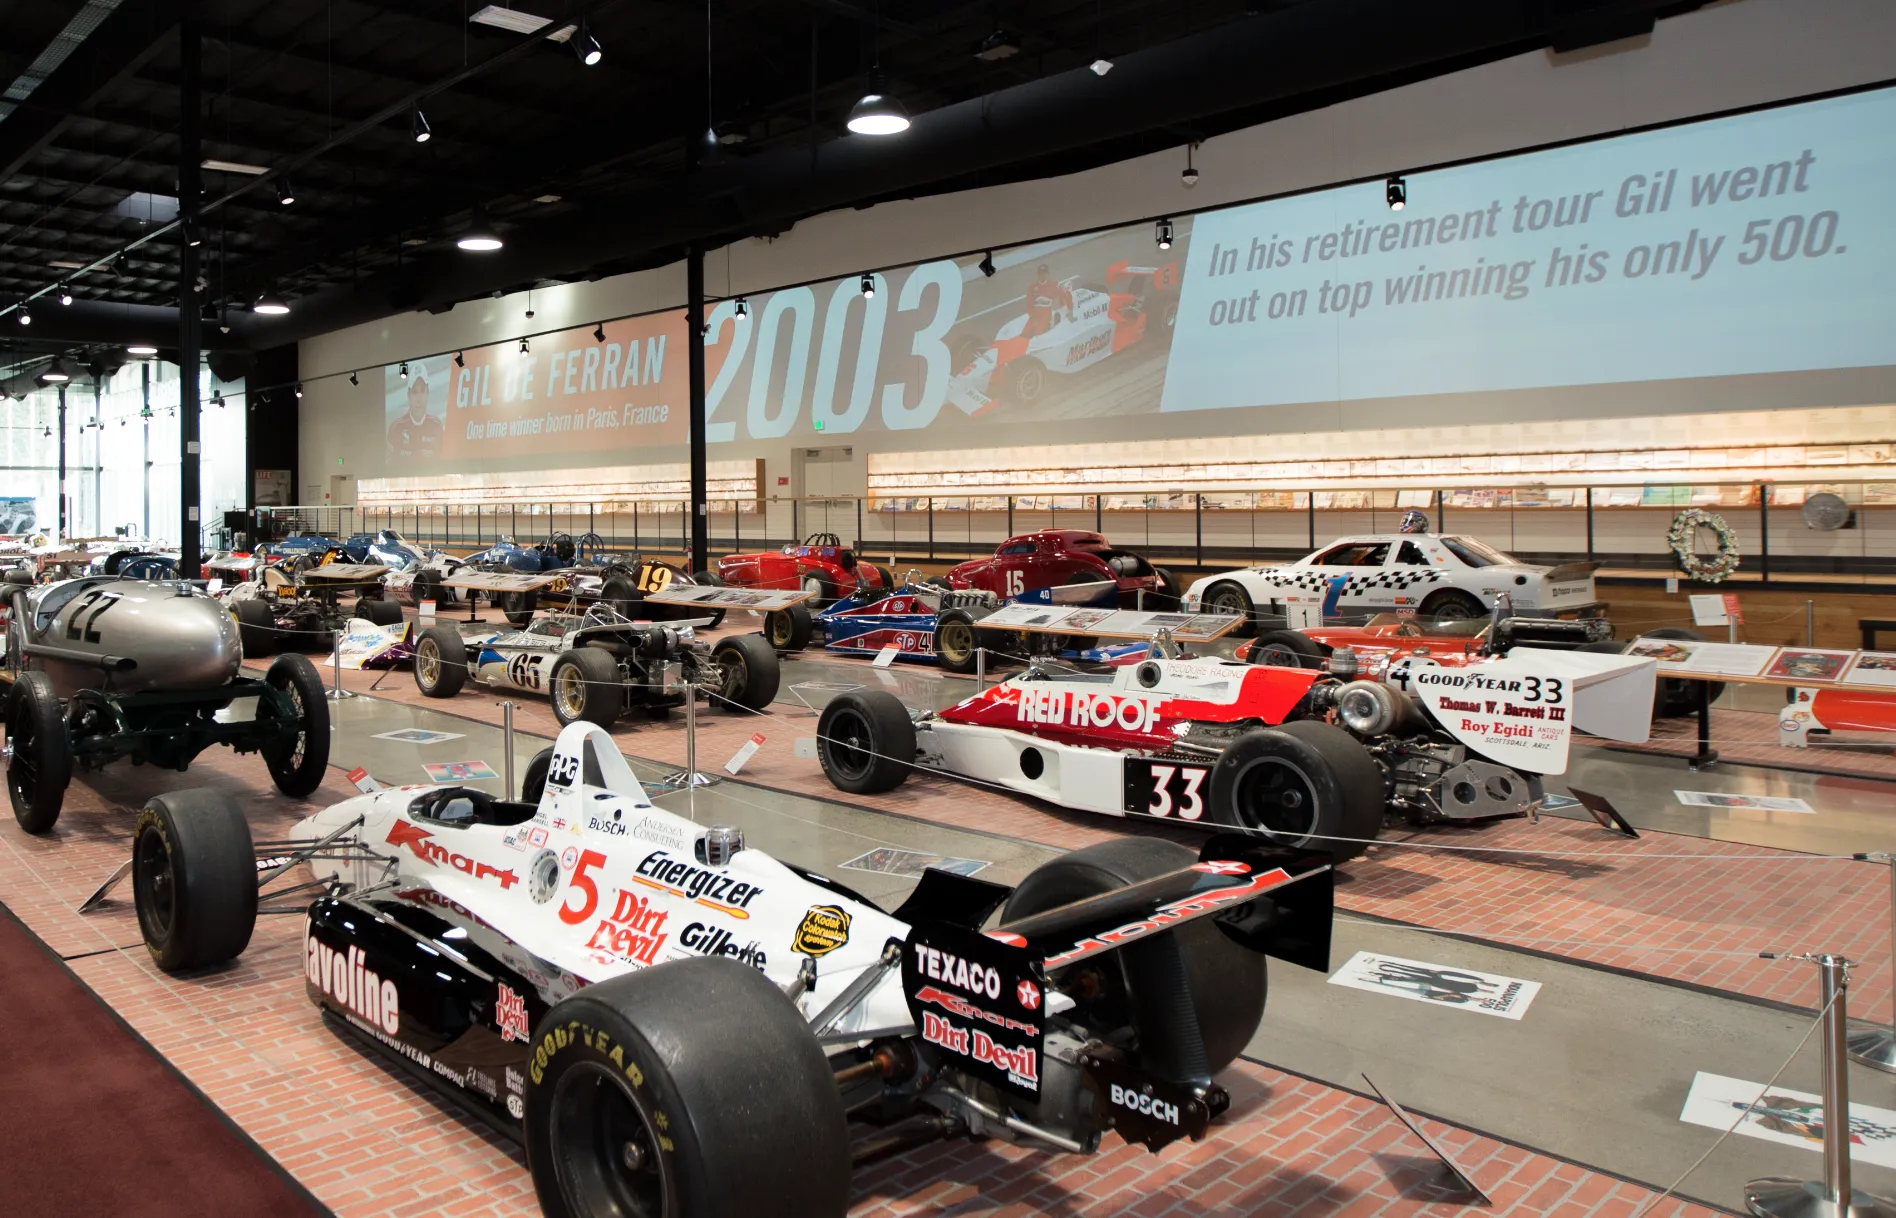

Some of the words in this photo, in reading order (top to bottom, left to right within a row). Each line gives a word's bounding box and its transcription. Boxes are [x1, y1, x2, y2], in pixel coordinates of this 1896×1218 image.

[1208, 243, 1237, 278] In
[1246, 234, 1293, 271] his
[1303, 202, 1502, 265] retirement
[1512, 189, 1602, 234] tour
[1615, 168, 1677, 218] Gil
[1689, 149, 1816, 208] went
[1209, 289, 1259, 326] out
[1267, 286, 1307, 320] on
[1318, 273, 1373, 318] top
[1383, 256, 1536, 305] winning
[1545, 242, 1610, 288] his
[1622, 229, 1726, 281] only
[1737, 210, 1848, 266] 500.
[687, 257, 963, 443] 2003
[456, 364, 492, 409] GIL
[504, 355, 539, 403] DE
[547, 334, 666, 398] FERRAN
[466, 420, 483, 440] One
[486, 419, 508, 439] time
[509, 416, 545, 438] winner
[546, 411, 571, 433] born
[573, 411, 584, 432] in
[586, 408, 620, 432] Paris,
[622, 403, 669, 426] France
[256, 470, 272, 480] LIFE
[637, 564, 672, 594] 19
[1005, 569, 1025, 597] 15
[1039, 590, 1050, 600] 40
[1322, 571, 1354, 618] 1
[66, 589, 124, 645] 22
[895, 634, 915, 651] STP
[919, 632, 933, 654] 4
[512, 653, 544, 690] 65
[1166, 662, 1207, 676] THEODORE
[1210, 668, 1244, 679] RACING
[1418, 673, 1521, 693] GOODYEAR
[1523, 676, 1563, 704] 33
[1017, 688, 1066, 725] RED
[1068, 691, 1162, 733] ROOF
[1439, 696, 1481, 713] Thomas
[1485, 700, 1500, 715] W.
[1503, 702, 1545, 720] Barrett
[1548, 707, 1565, 721] III
[1461, 718, 1490, 735] Roy
[1493, 722, 1533, 738] Egidi
[1537, 727, 1564, 735] ANTIQUE
[1484, 737, 1529, 748] SCOTTSDALE,
[1540, 733, 1558, 741] CARS
[549, 755, 579, 782] PPG
[1148, 763, 1208, 821] 33
[588, 817, 626, 836] BOSCH
[633, 825, 685, 850] CONSULTING
[638, 816, 685, 837] ANDERSEN
[385, 819, 520, 890] Kmart
[558, 848, 608, 926] 5
[634, 850, 766, 910] Energizer
[609, 888, 669, 937] Dirt
[814, 913, 842, 930] Kodak
[584, 919, 669, 967] Devil
[802, 921, 848, 942] Colorwatch
[803, 934, 834, 948] system
[915, 943, 1000, 1000] TEXACO
[498, 982, 525, 1014] Dirt
[915, 985, 1040, 1038] Kmart
[495, 1000, 529, 1036] Devil
[530, 1020, 644, 1090] GOODYEAR
[922, 1010, 970, 1056] Dirt
[972, 1028, 1038, 1083] Devil
[433, 1060, 465, 1089] COMPAQ
[1110, 1083, 1180, 1127] BOSCH
